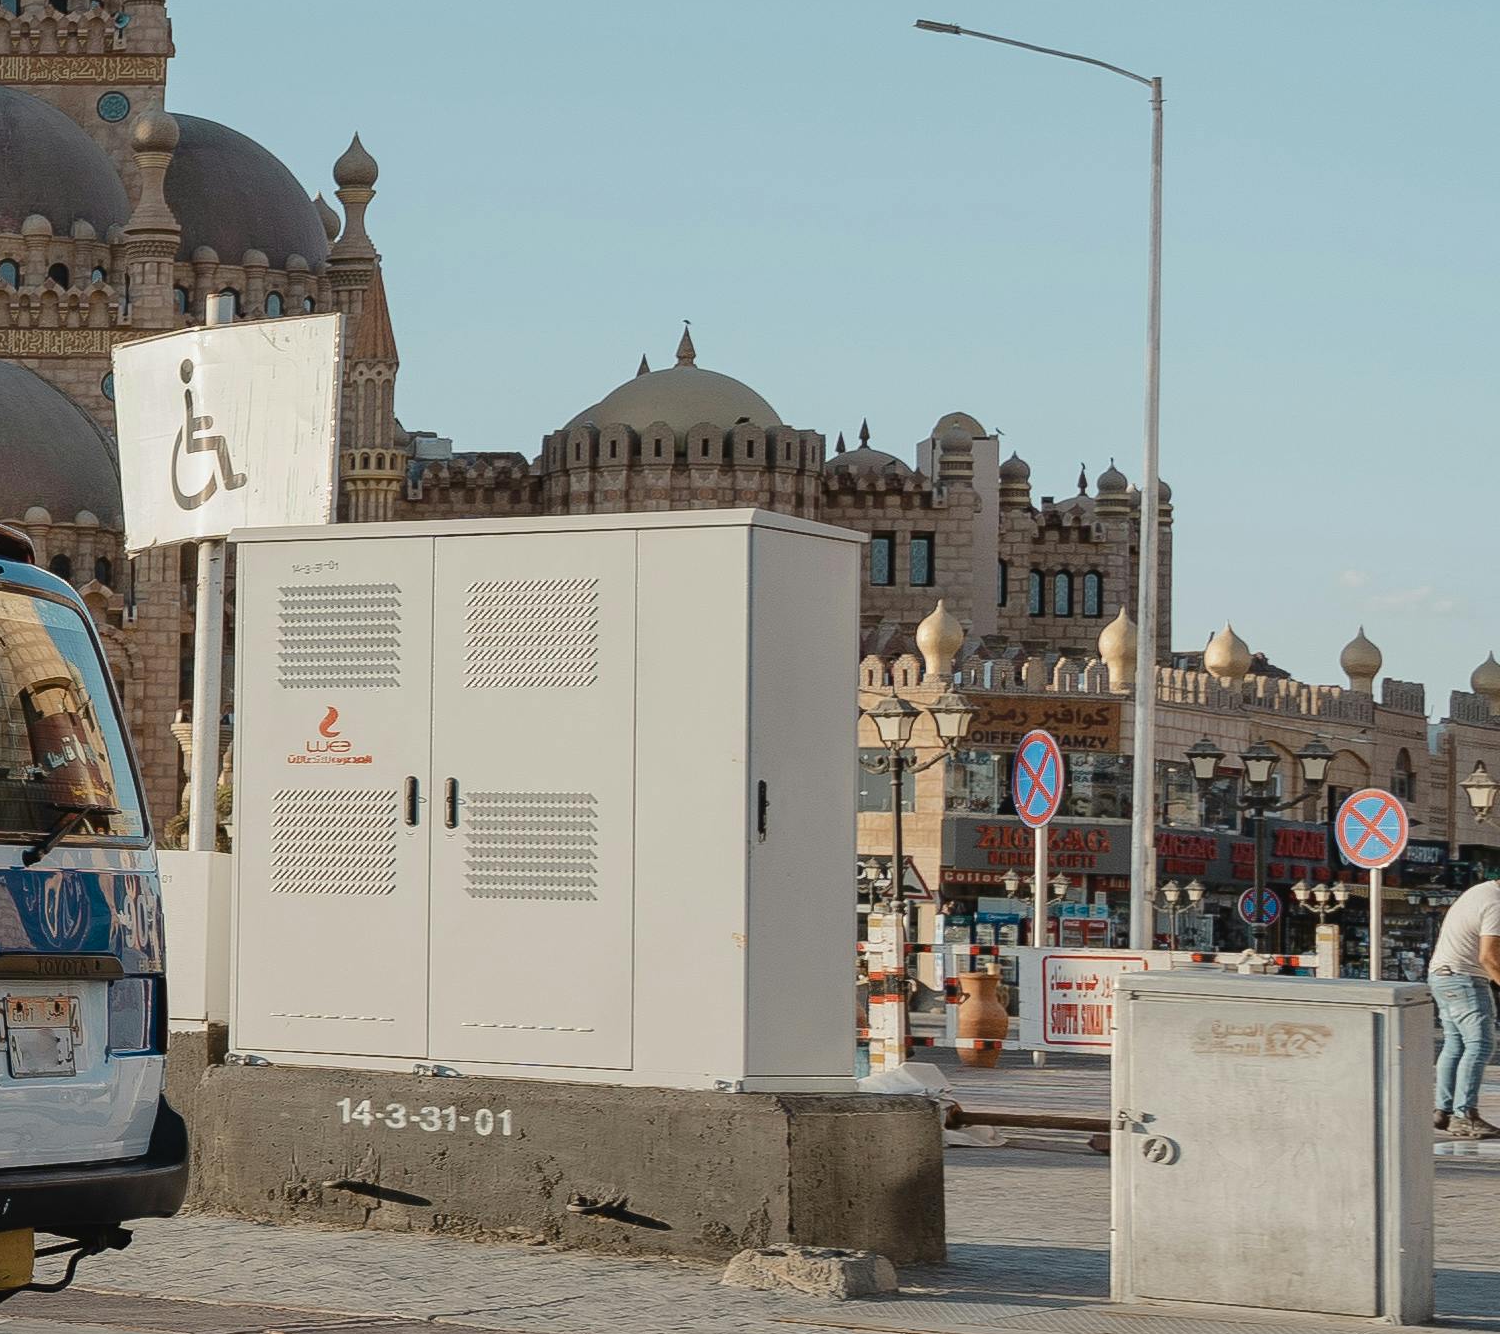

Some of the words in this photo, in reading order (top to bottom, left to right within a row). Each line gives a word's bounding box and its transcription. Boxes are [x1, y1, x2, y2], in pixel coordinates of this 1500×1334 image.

[306, 740, 352, 753] we
[1051, 1003, 1078, 1034] SOUTH
[1081, 1004, 1104, 1035] SINAI
[336, 1097, 513, 1136] 14-3-31-01
